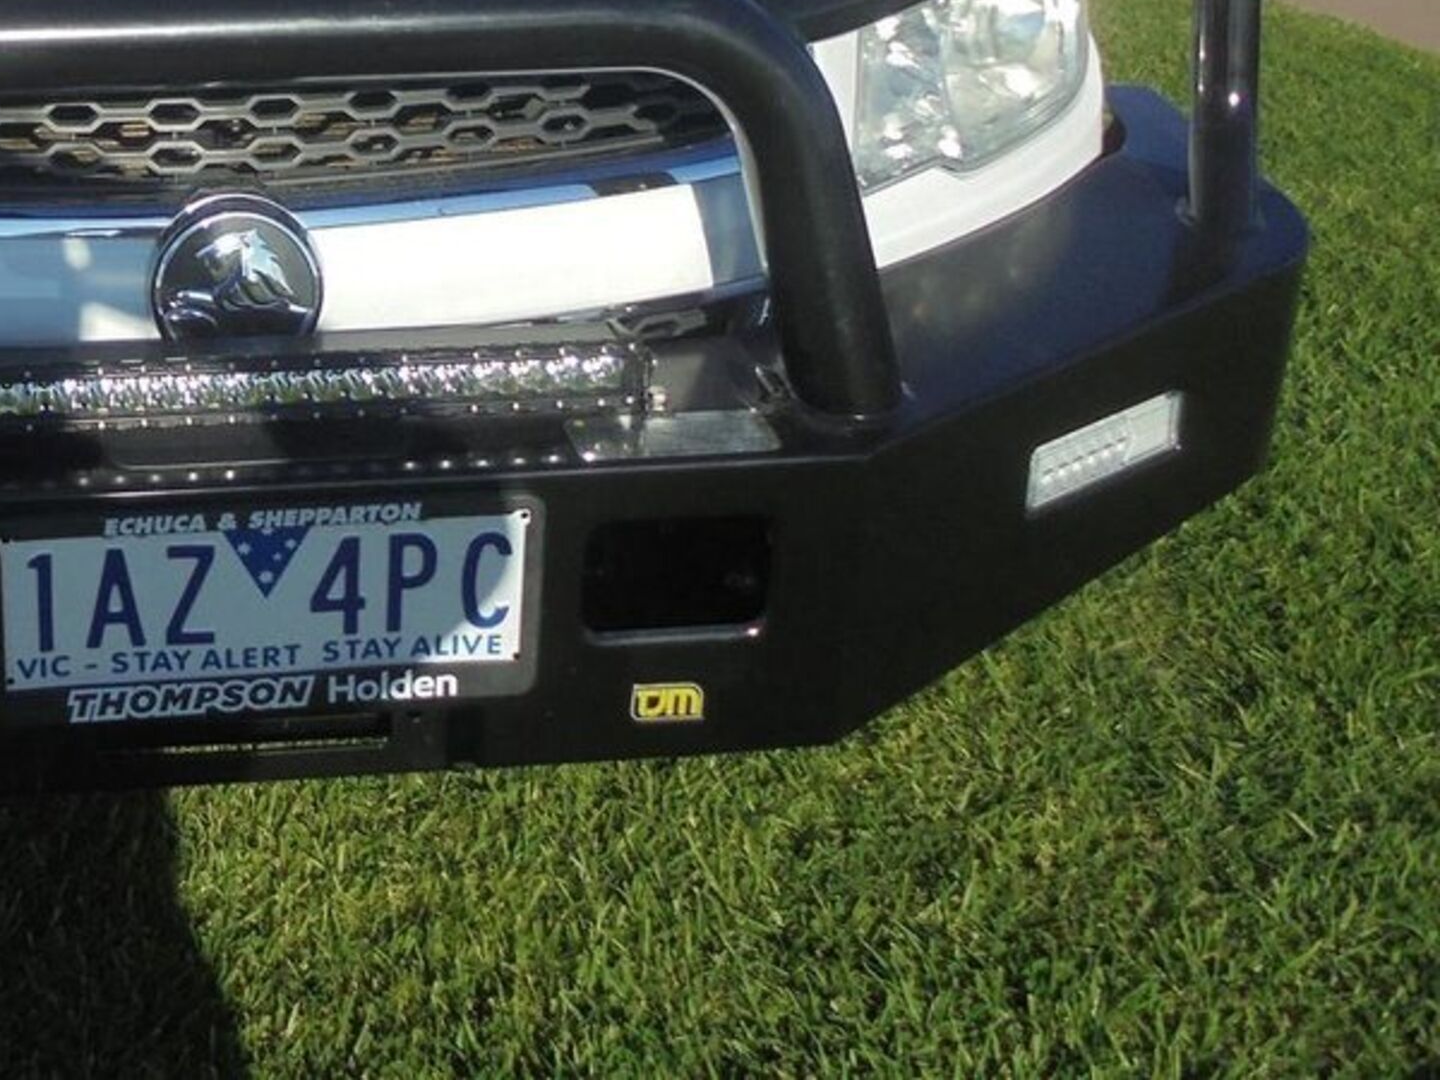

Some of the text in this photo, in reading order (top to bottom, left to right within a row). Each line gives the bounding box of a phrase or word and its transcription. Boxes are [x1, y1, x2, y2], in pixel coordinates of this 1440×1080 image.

[103, 502, 423, 537] ECHUCA & SHEPPARTON
[17, 654, 72, 680] VIC
[111, 648, 192, 674] STAY
[201, 643, 301, 671] ALERT
[322, 636, 403, 663] STAY
[409, 634, 502, 658] ALIVE
[67, 671, 458, 723] THOMPSON Holden
